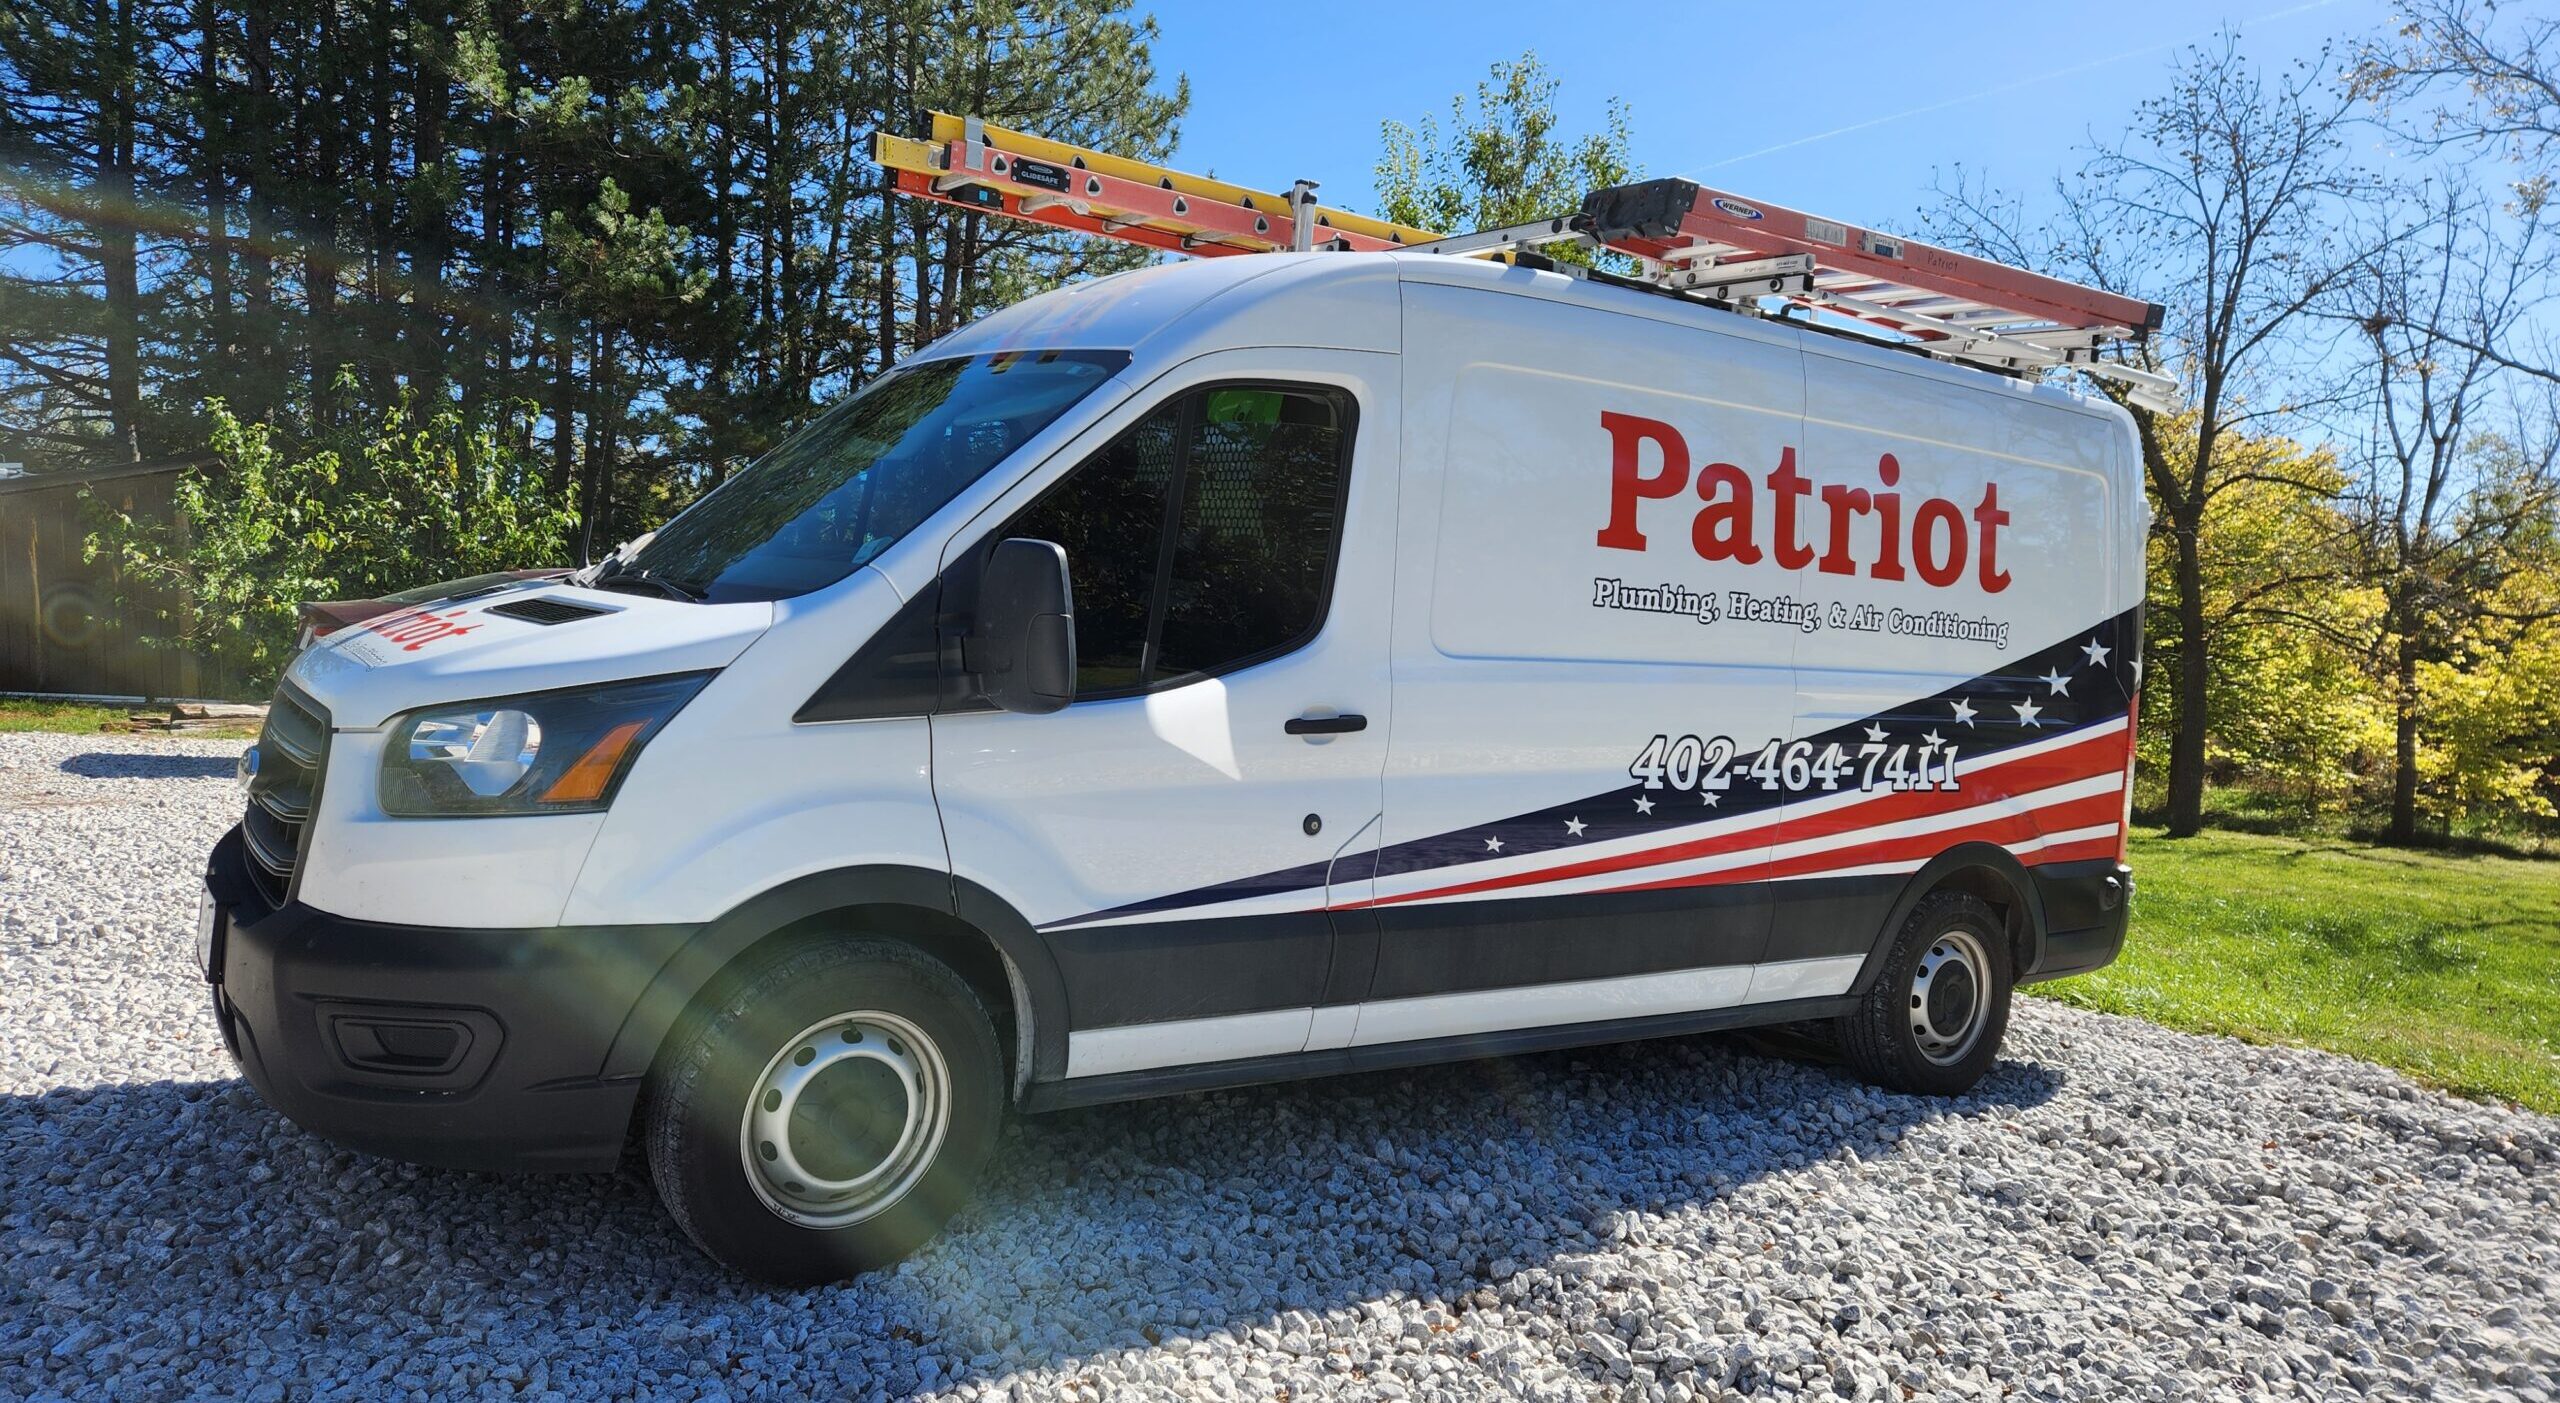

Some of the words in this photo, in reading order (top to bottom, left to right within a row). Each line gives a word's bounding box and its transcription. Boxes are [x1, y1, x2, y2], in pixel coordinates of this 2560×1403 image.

[1021, 170, 1059, 185] GLIDESAFE
[1722, 201, 1755, 216] WERNER
[1597, 410, 2012, 594] Patriot
[1593, 577, 1720, 625] Plumbing,
[1727, 591, 1821, 633] Heating,
[1828, 602, 1846, 628] &
[1849, 604, 1884, 632] Air
[1888, 607, 2009, 650] Conditioning
[1629, 734, 1961, 793] 402-464-7411
